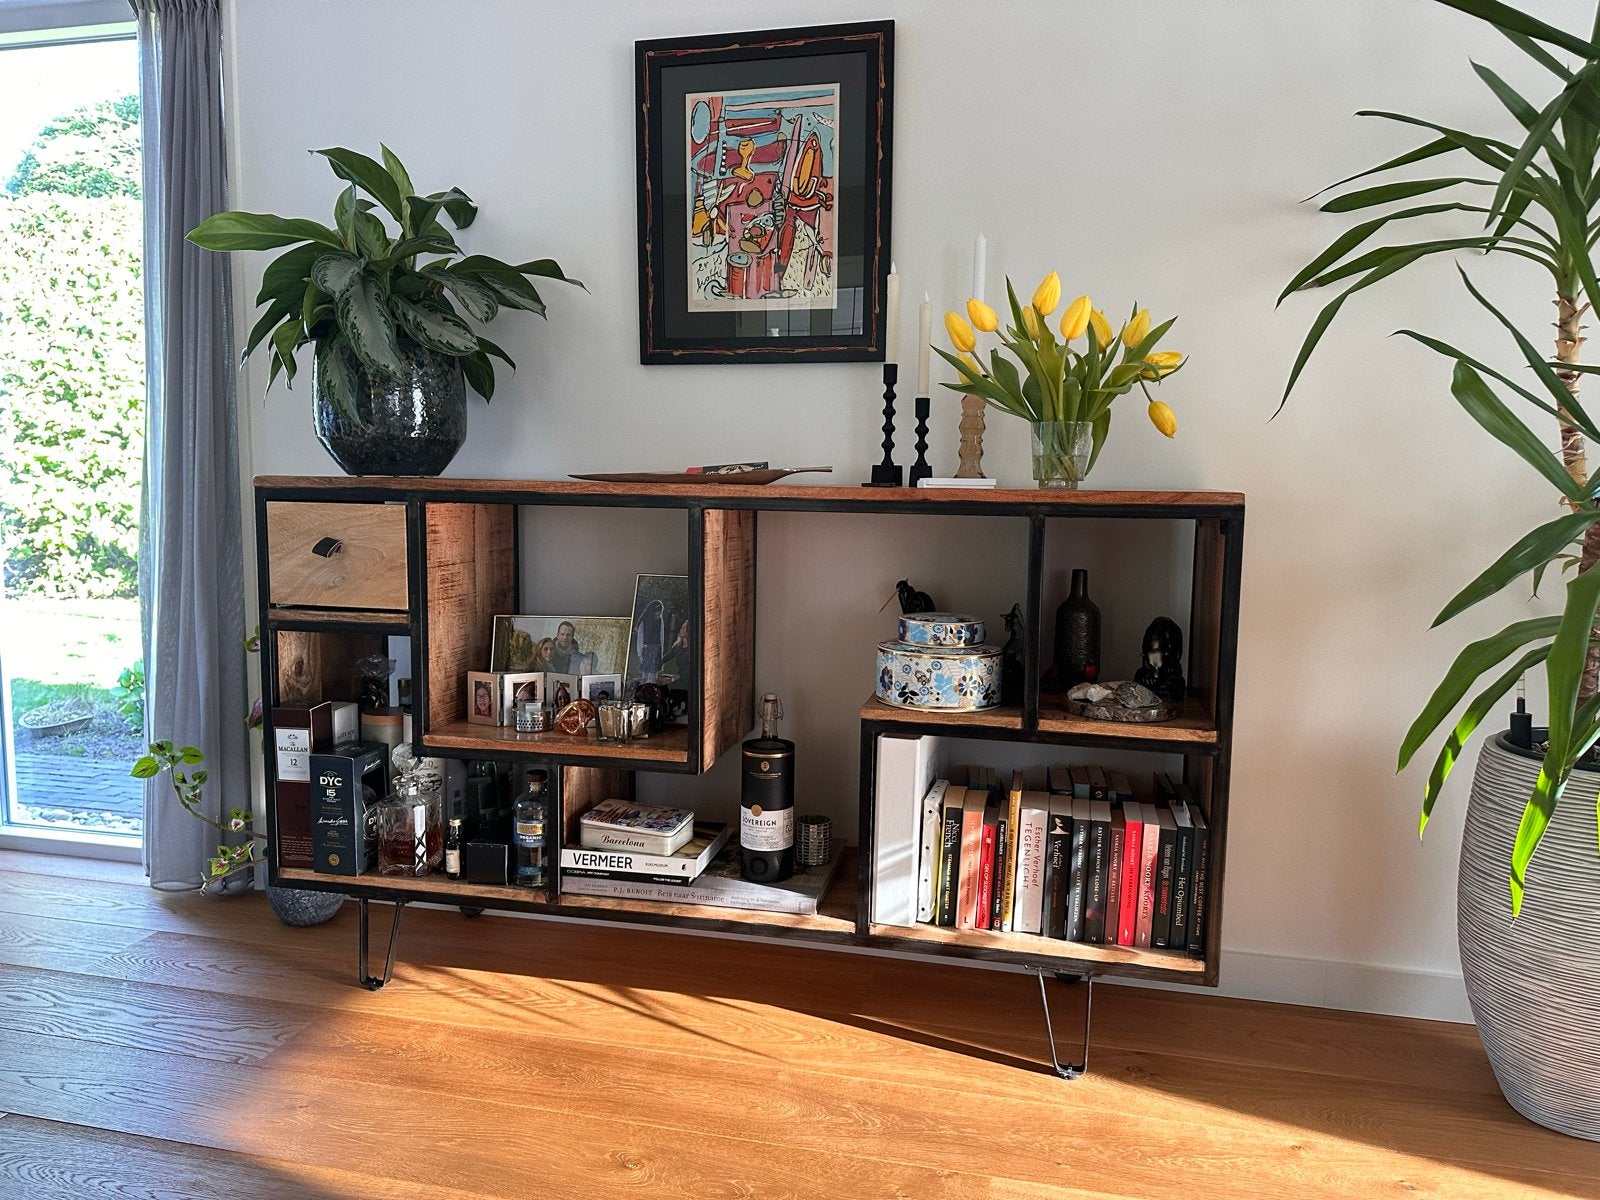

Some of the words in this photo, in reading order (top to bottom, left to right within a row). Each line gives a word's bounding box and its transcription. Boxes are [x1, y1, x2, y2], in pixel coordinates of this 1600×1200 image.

[290, 758, 299, 766] 12
[319, 776, 343, 786] DYC
[326, 789, 337, 797] 15
[742, 816, 777, 827] SOVEREIGN
[601, 834, 646, 847] Barcelona
[944, 819, 955, 848] French
[951, 823, 960, 843] Nicci
[1034, 826, 1043, 852] Esther
[1053, 840, 1063, 869] Verhoef
[1147, 833, 1155, 858] SASKIA
[573, 853, 632, 869] VERMEER
[1023, 822, 1033, 890] TEGENLICHT
[1031, 855, 1042, 887] Verhoef
[1144, 860, 1152, 886] NOORT
[1177, 877, 1186, 891] Het
[626, 888, 652, 896] BENOIT
[657, 888, 671, 896] Reis
[690, 891, 725, 903] Suriname
[1142, 889, 1151, 920] KOORTS
[1174, 891, 1185, 926] Opiumbed
[1196, 896, 1204, 916] COFFEE
